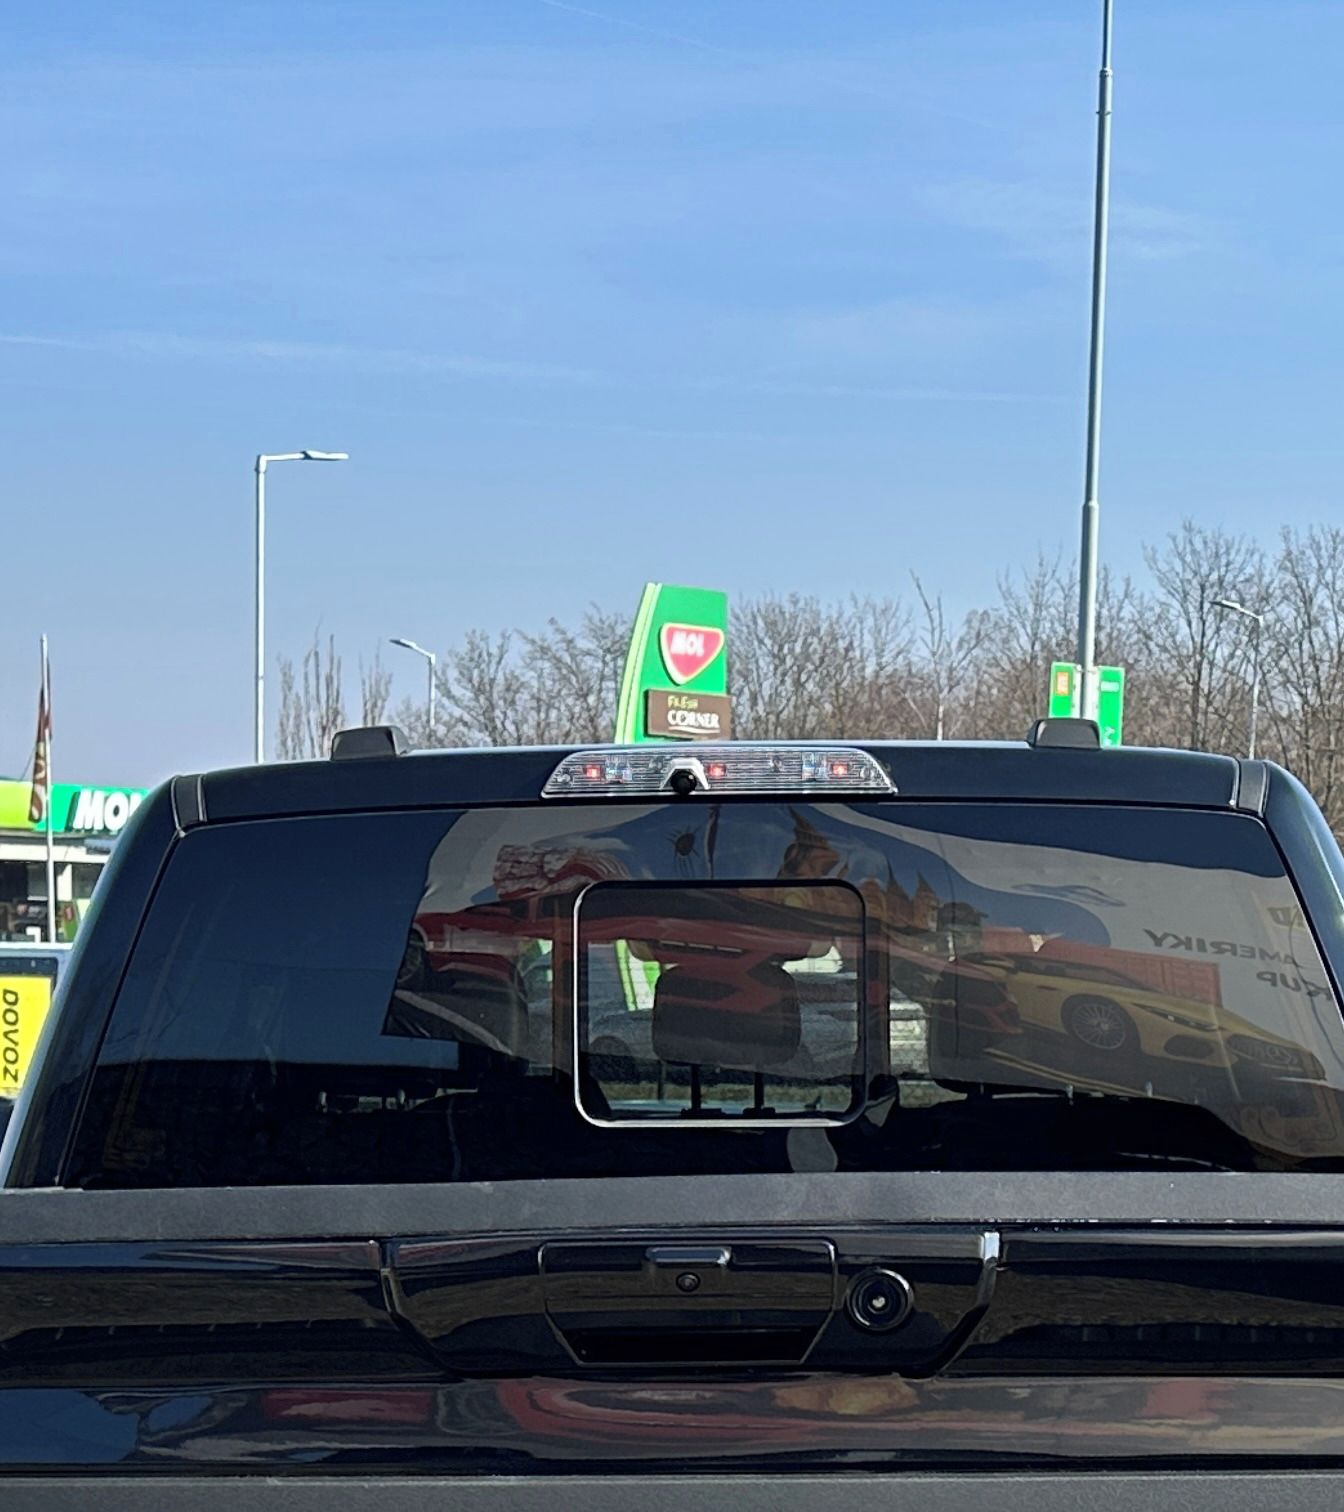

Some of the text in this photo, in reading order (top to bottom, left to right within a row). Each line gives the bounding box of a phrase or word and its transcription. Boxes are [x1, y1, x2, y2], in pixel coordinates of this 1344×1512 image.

[670, 631, 704, 656] MOL
[667, 710, 720, 728] CORNER
[2, 988, 19, 1083] DOVOZ
